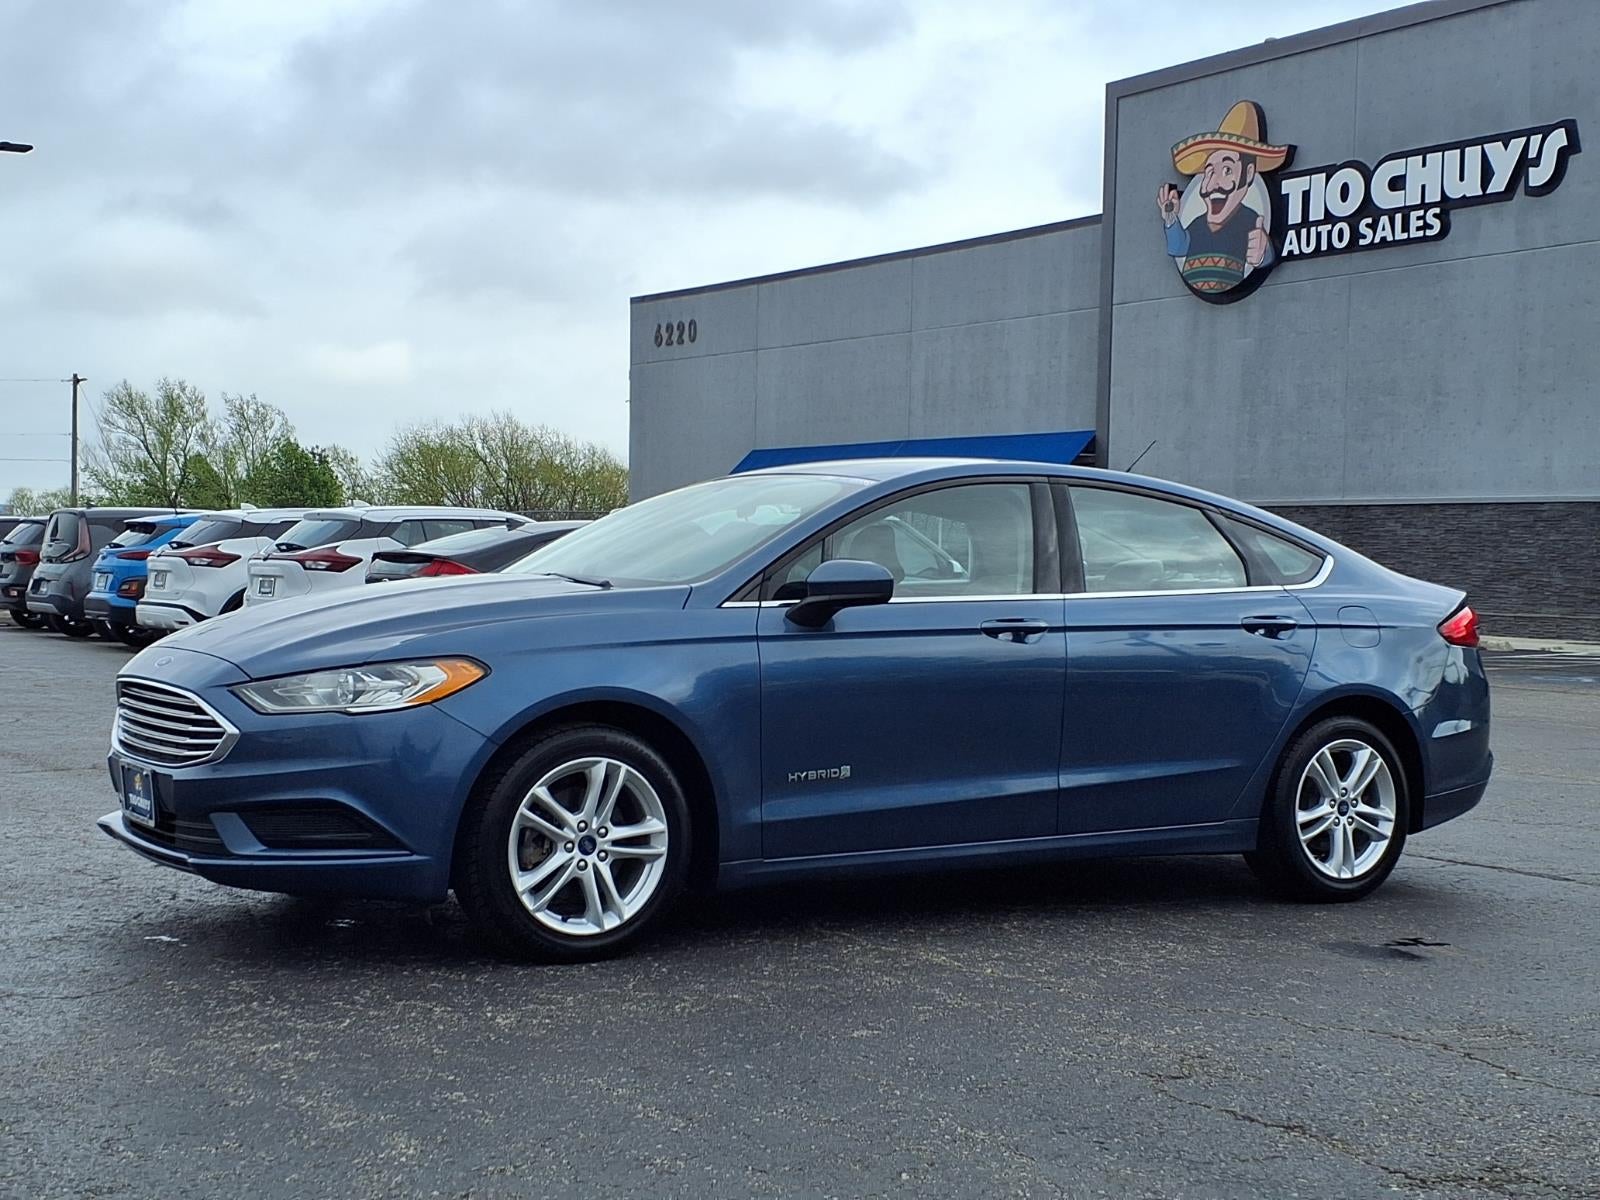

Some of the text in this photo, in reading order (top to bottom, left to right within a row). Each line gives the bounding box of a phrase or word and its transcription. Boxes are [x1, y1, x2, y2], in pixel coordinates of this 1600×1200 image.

[1282, 128, 1568, 225] TIO CHUY'S
[1281, 207, 1442, 257] AUTO SALES
[654, 319, 697, 347] 6220
[788, 768, 840, 782] HYBRID
